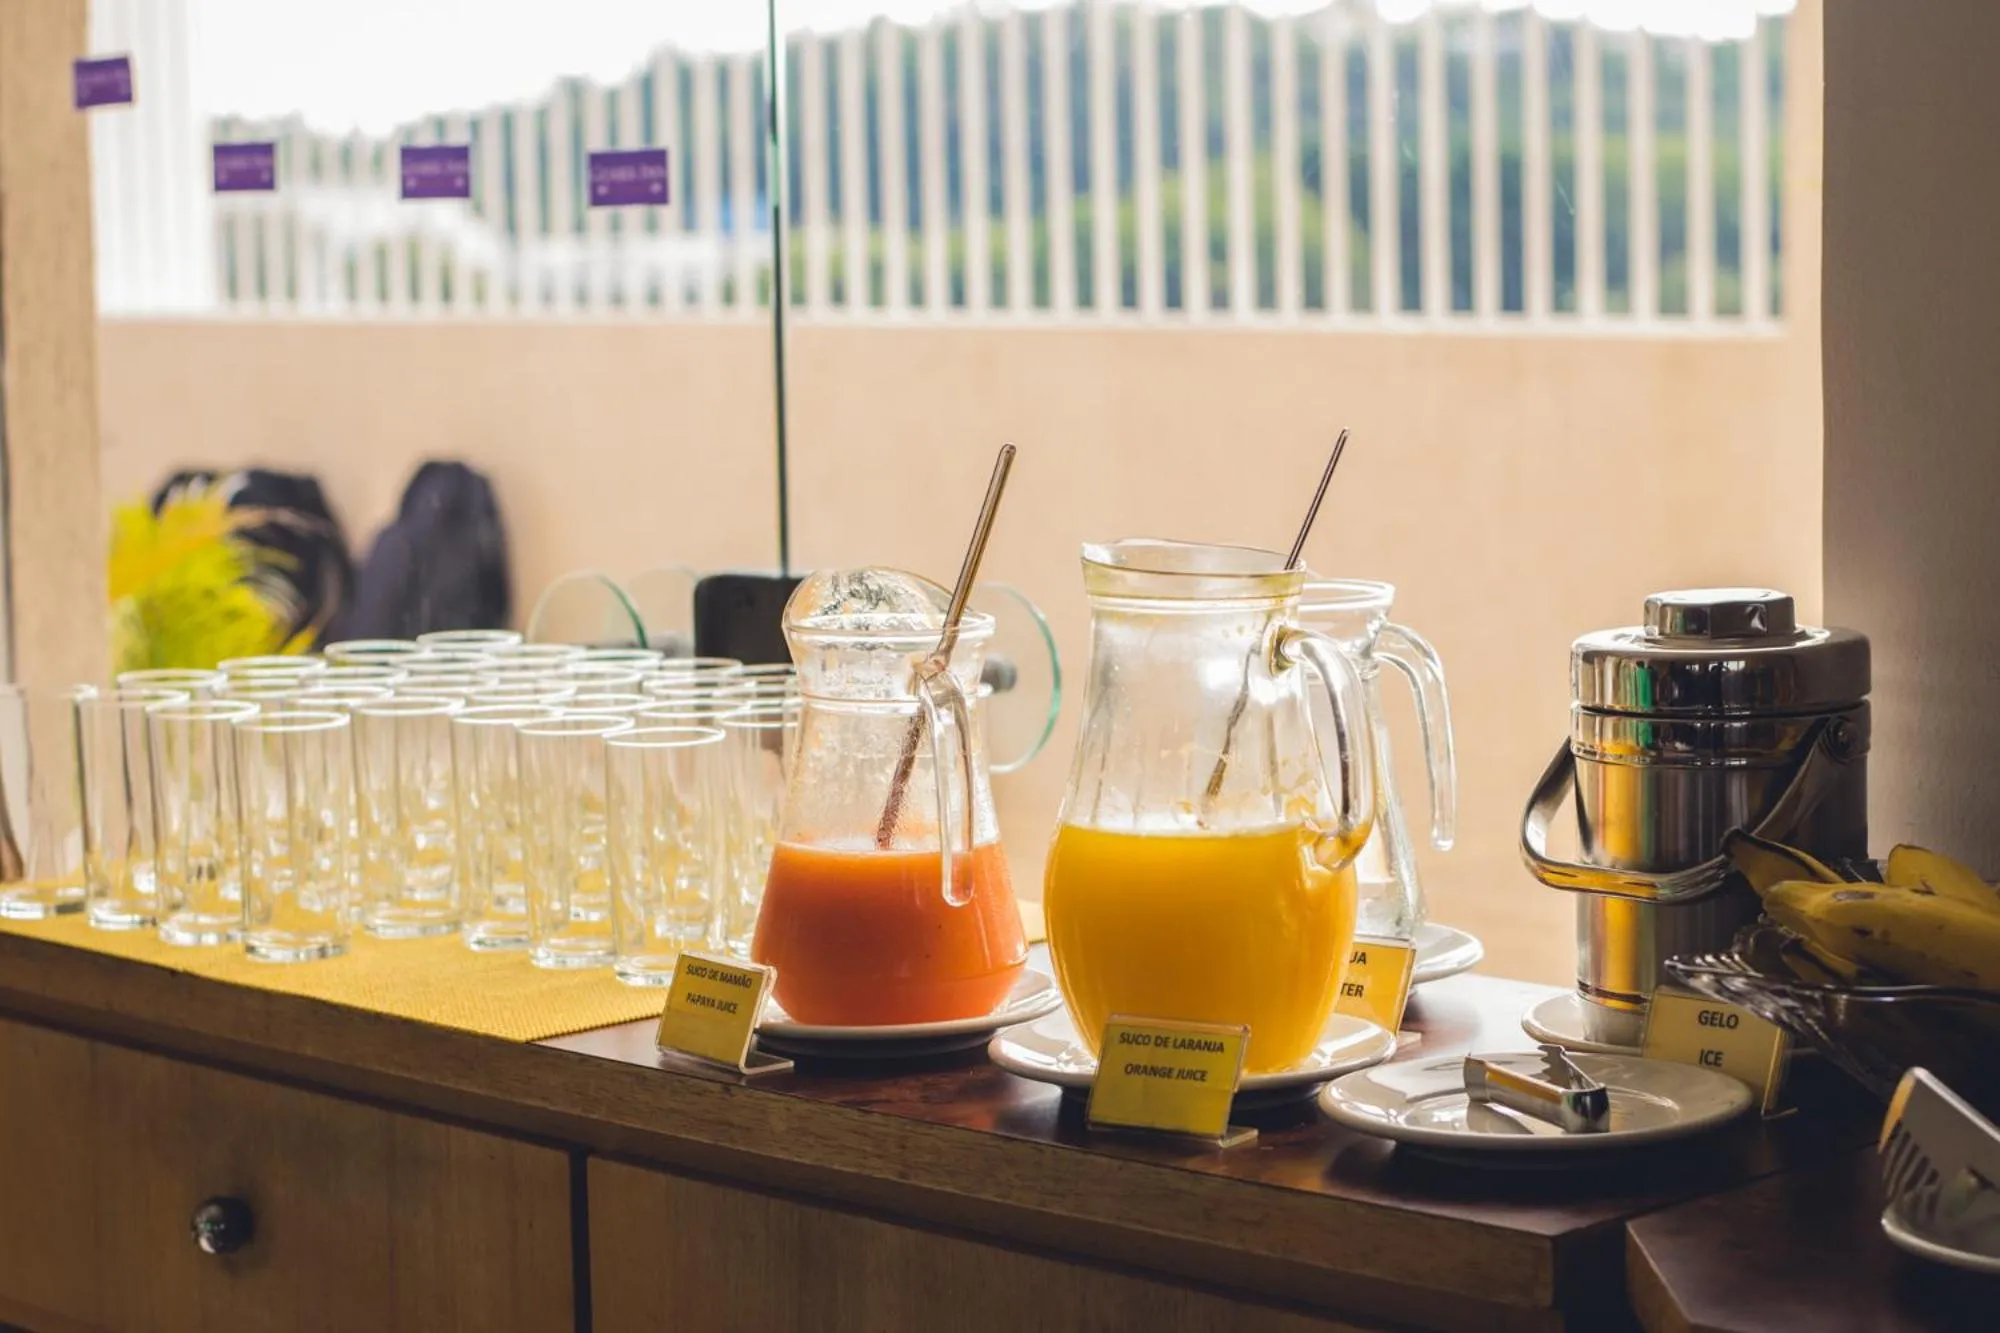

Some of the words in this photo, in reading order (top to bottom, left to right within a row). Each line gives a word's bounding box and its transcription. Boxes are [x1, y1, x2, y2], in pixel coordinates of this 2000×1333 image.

[686, 963, 707, 978] SUCO
[708, 968, 720, 981] DE
[720, 971, 752, 989] MAMÃO
[1340, 982, 1364, 998] TER
[686, 992, 715, 1008] PAPAYA
[716, 999, 738, 1015] JUICE
[1698, 1009, 1740, 1029] GELO
[1119, 1032, 1152, 1046] SUCO
[1154, 1036, 1171, 1048] DE
[1172, 1039, 1225, 1053] LARANJA
[1698, 1048, 1724, 1067] ICE
[1124, 1063, 1174, 1079] ORANGE
[1175, 1069, 1208, 1082] JUICE
